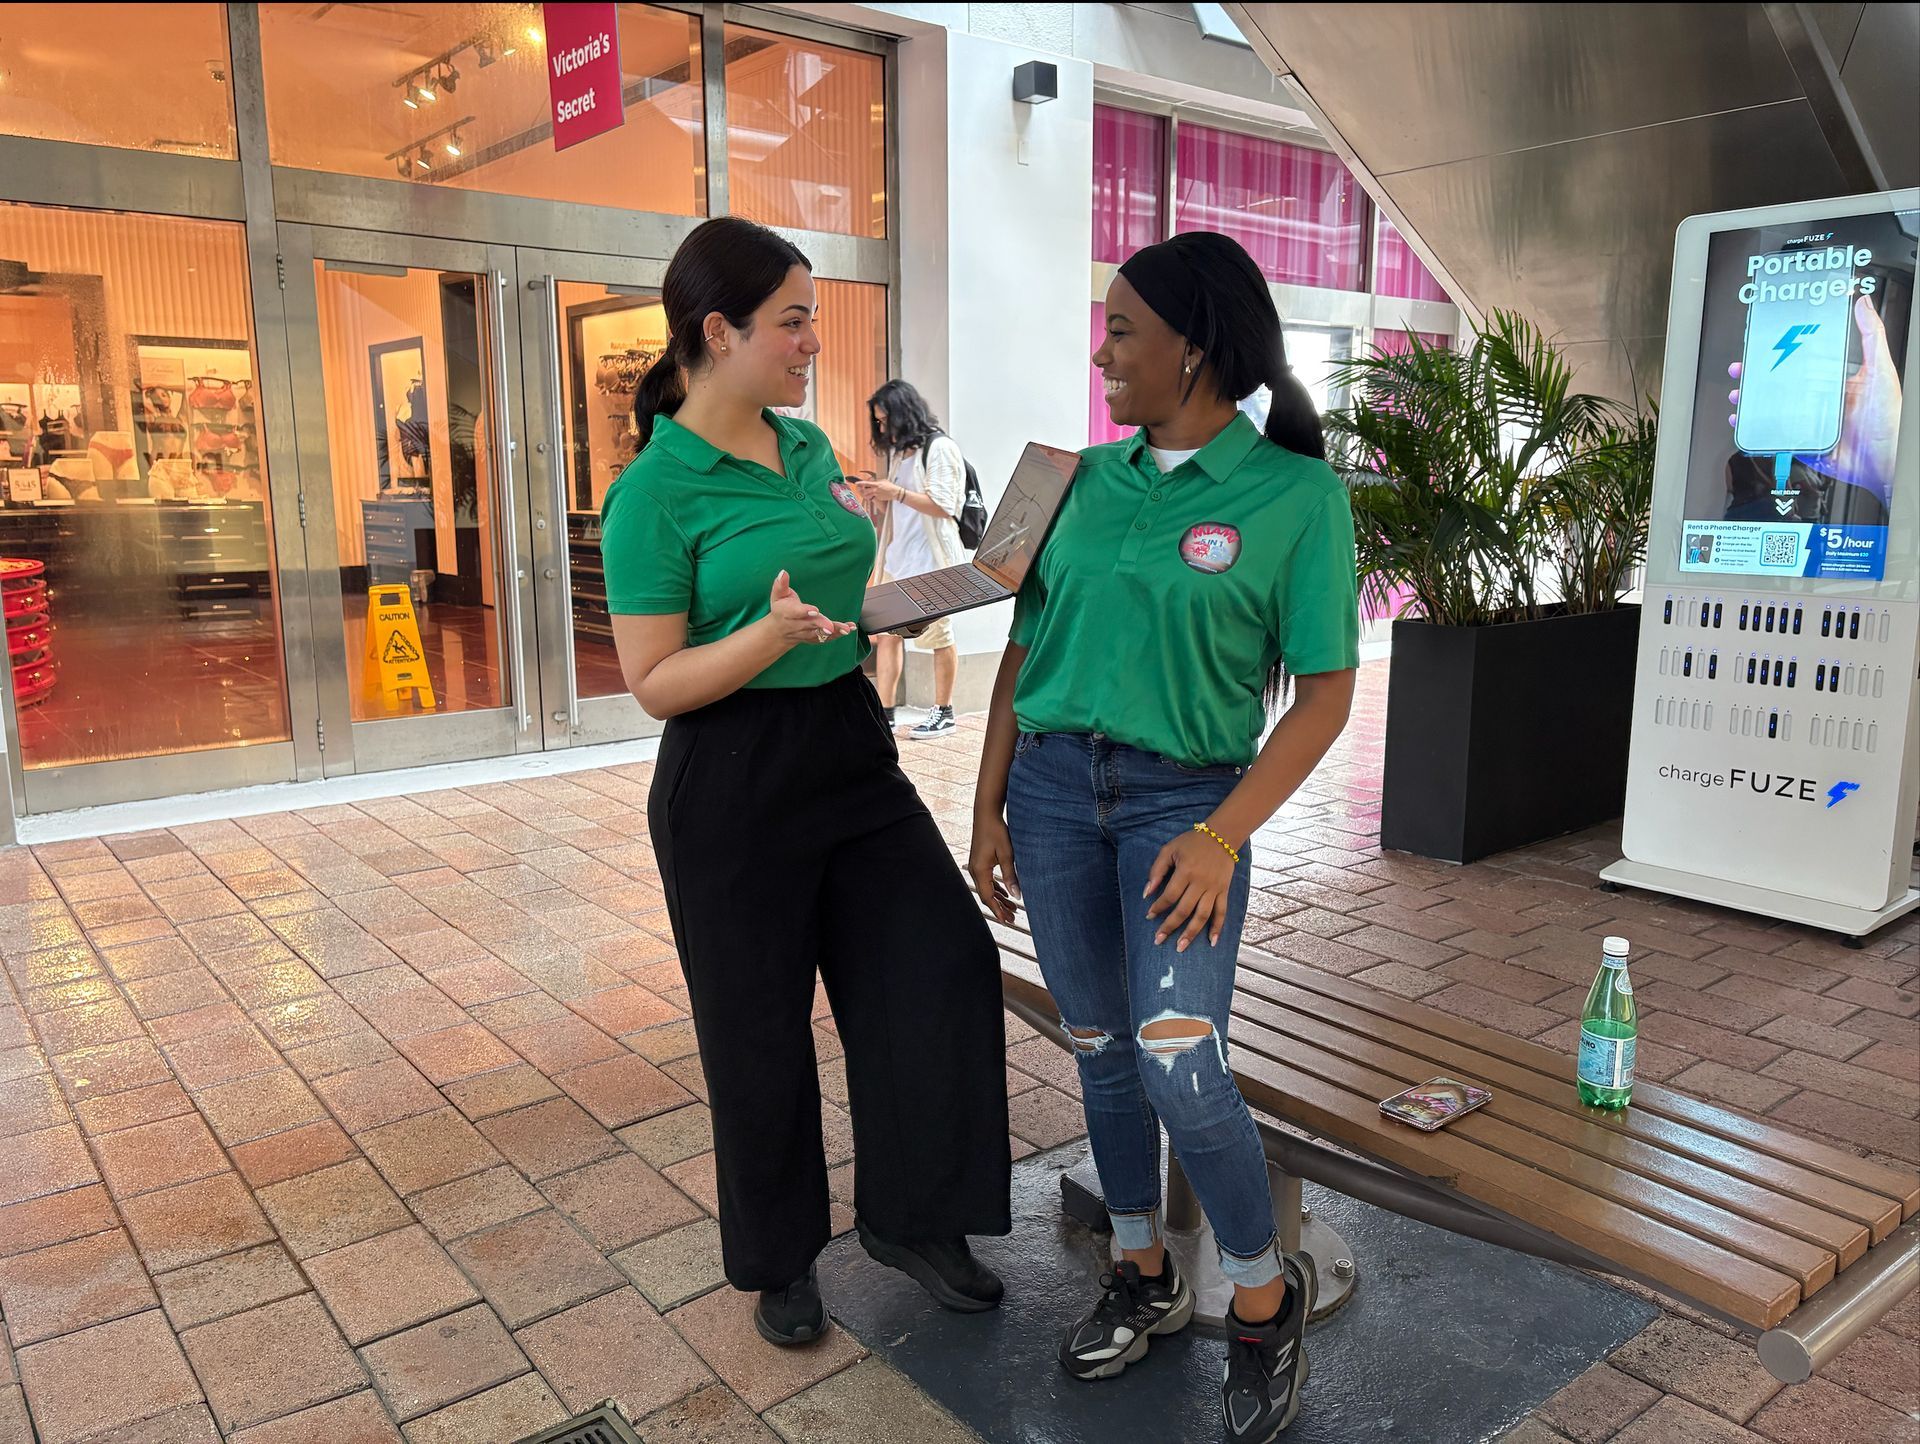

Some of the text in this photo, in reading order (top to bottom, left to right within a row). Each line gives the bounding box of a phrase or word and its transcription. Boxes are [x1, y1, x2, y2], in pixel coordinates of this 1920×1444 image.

[553, 32, 610, 77] Victoria's
[557, 87, 596, 123] Secret
[1747, 245, 1872, 277] Portable
[1739, 276, 1876, 305] Chargers
[1732, 525, 1762, 533] Charger
[379, 612, 410, 621] CAUTION
